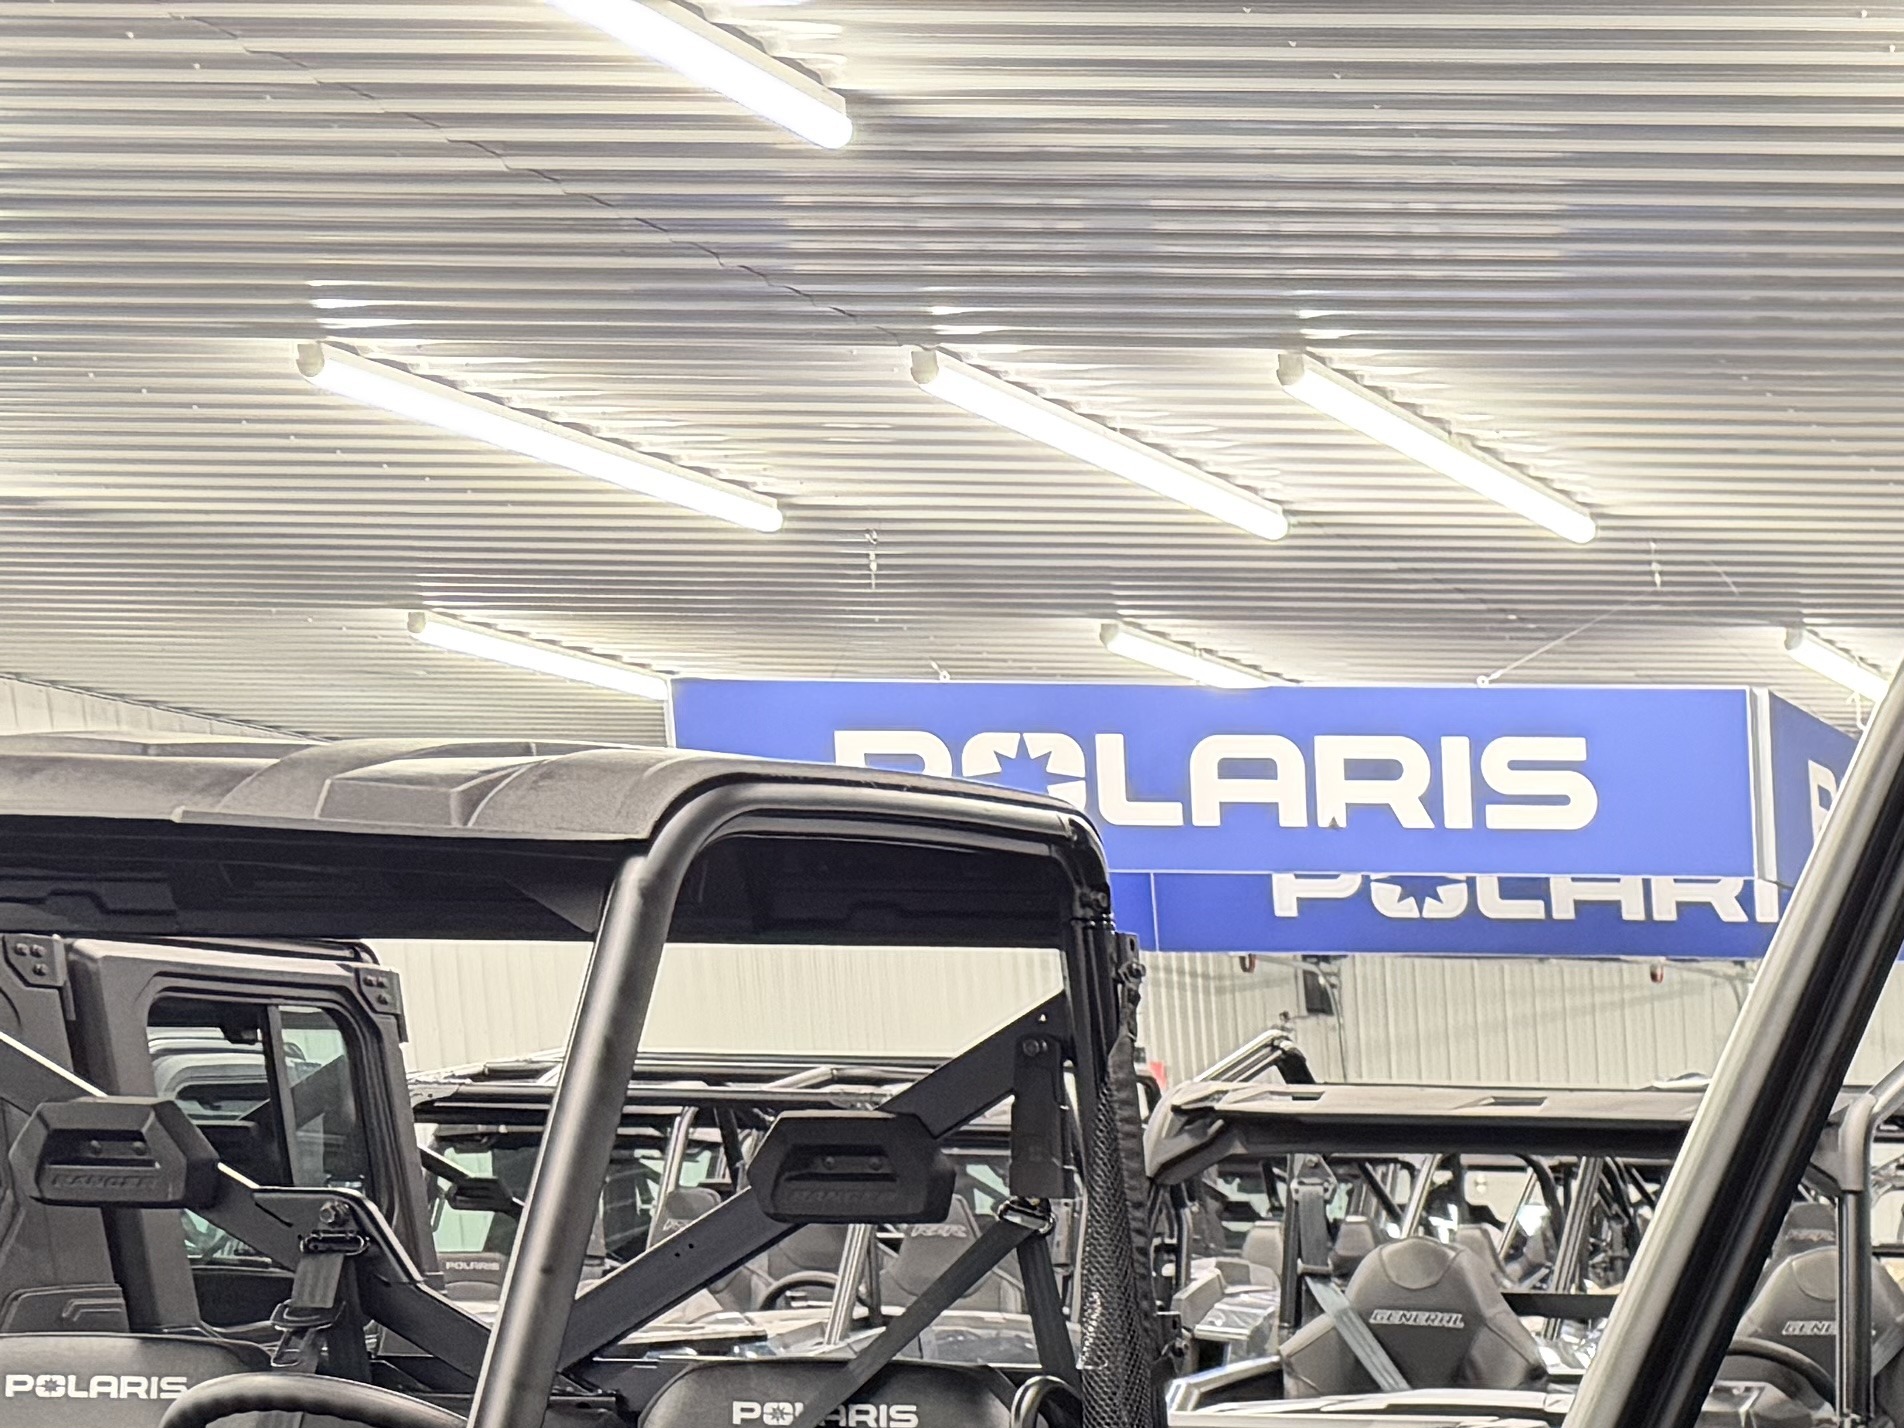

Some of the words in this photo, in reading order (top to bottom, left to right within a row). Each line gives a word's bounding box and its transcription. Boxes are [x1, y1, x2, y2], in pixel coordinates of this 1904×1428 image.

[1273, 875, 1779, 921] POLARI
[445, 1261, 500, 1271] POLARIS
[5, 1374, 188, 1400] POLARIS
[732, 1401, 919, 1428] POARIS
